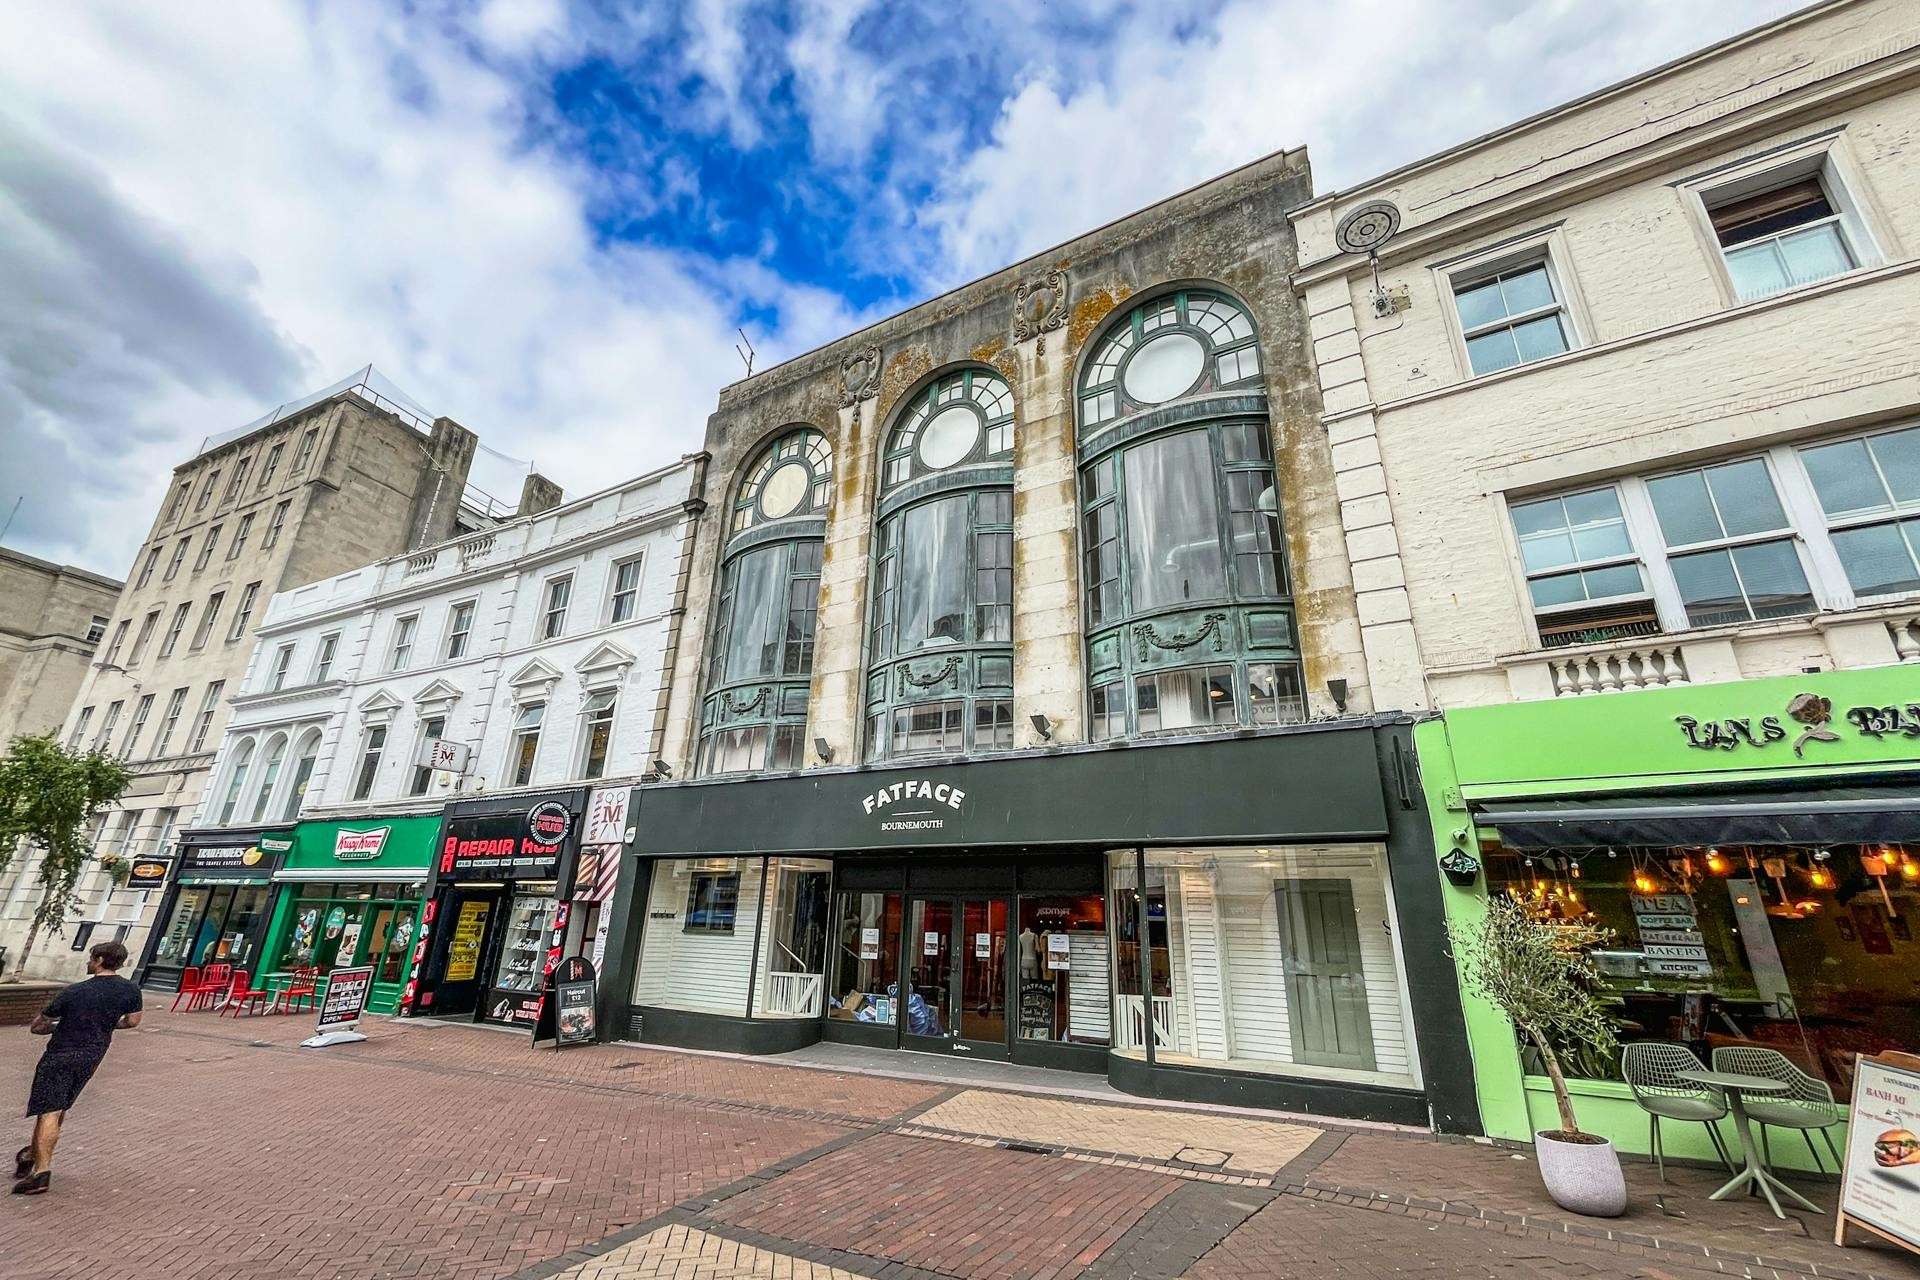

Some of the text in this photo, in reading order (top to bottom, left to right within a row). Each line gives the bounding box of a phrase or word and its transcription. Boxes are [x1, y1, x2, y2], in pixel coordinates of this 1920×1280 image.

[862, 780, 965, 815] FATFACE
[881, 820, 943, 831] BOURNEMOUTH
[457, 839, 515, 857] REPAIR
[1638, 897, 1686, 911] TEA
[1641, 916, 1692, 924] COFFEE BAR
[1642, 933, 1702, 942] PATISSERIE
[1648, 947, 1702, 956] BAKERY
[1660, 964, 1698, 972] KITCHEN
[566, 988, 586, 996] Haircut
[322, 1014, 342, 1023] OPEN
